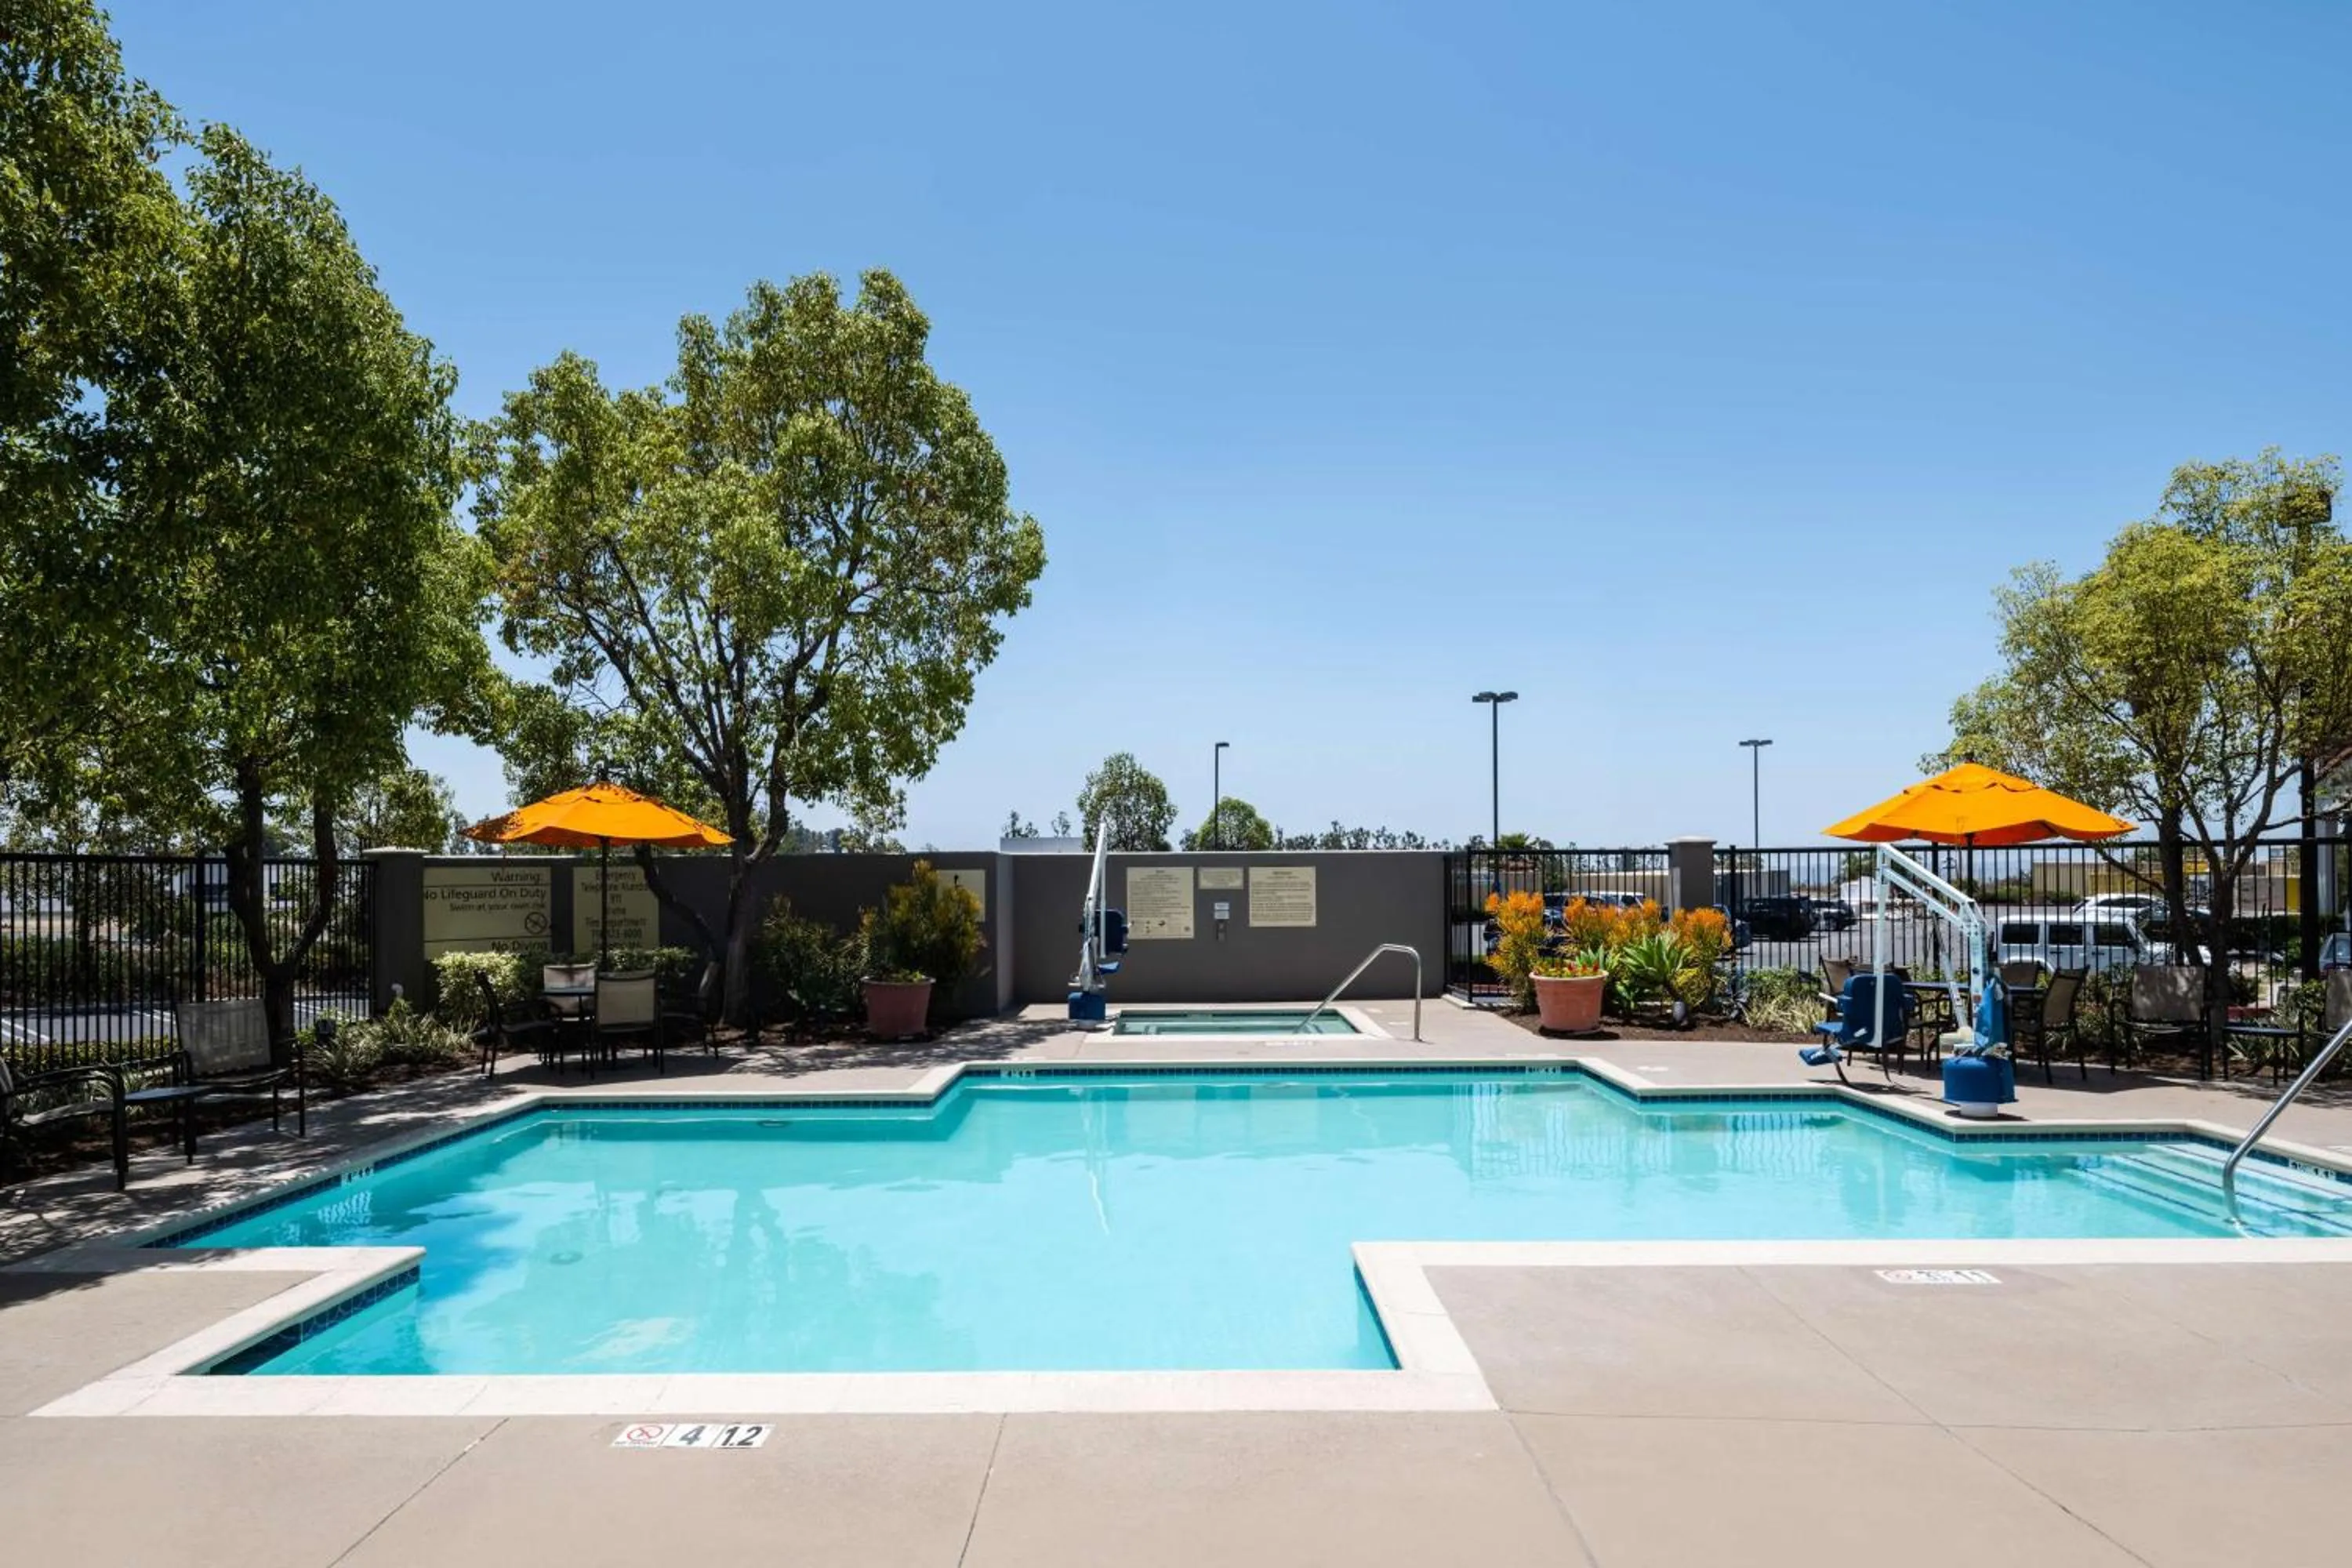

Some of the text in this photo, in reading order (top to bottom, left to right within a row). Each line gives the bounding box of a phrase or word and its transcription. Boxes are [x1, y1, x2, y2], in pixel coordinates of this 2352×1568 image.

[441, 889, 495, 902] Lifeguard
[499, 888, 516, 899] On
[520, 887, 546, 902] Duty
[449, 903, 474, 912] Swim
[492, 941, 508, 952] No
[679, 1425, 763, 1446] 4 1.2
